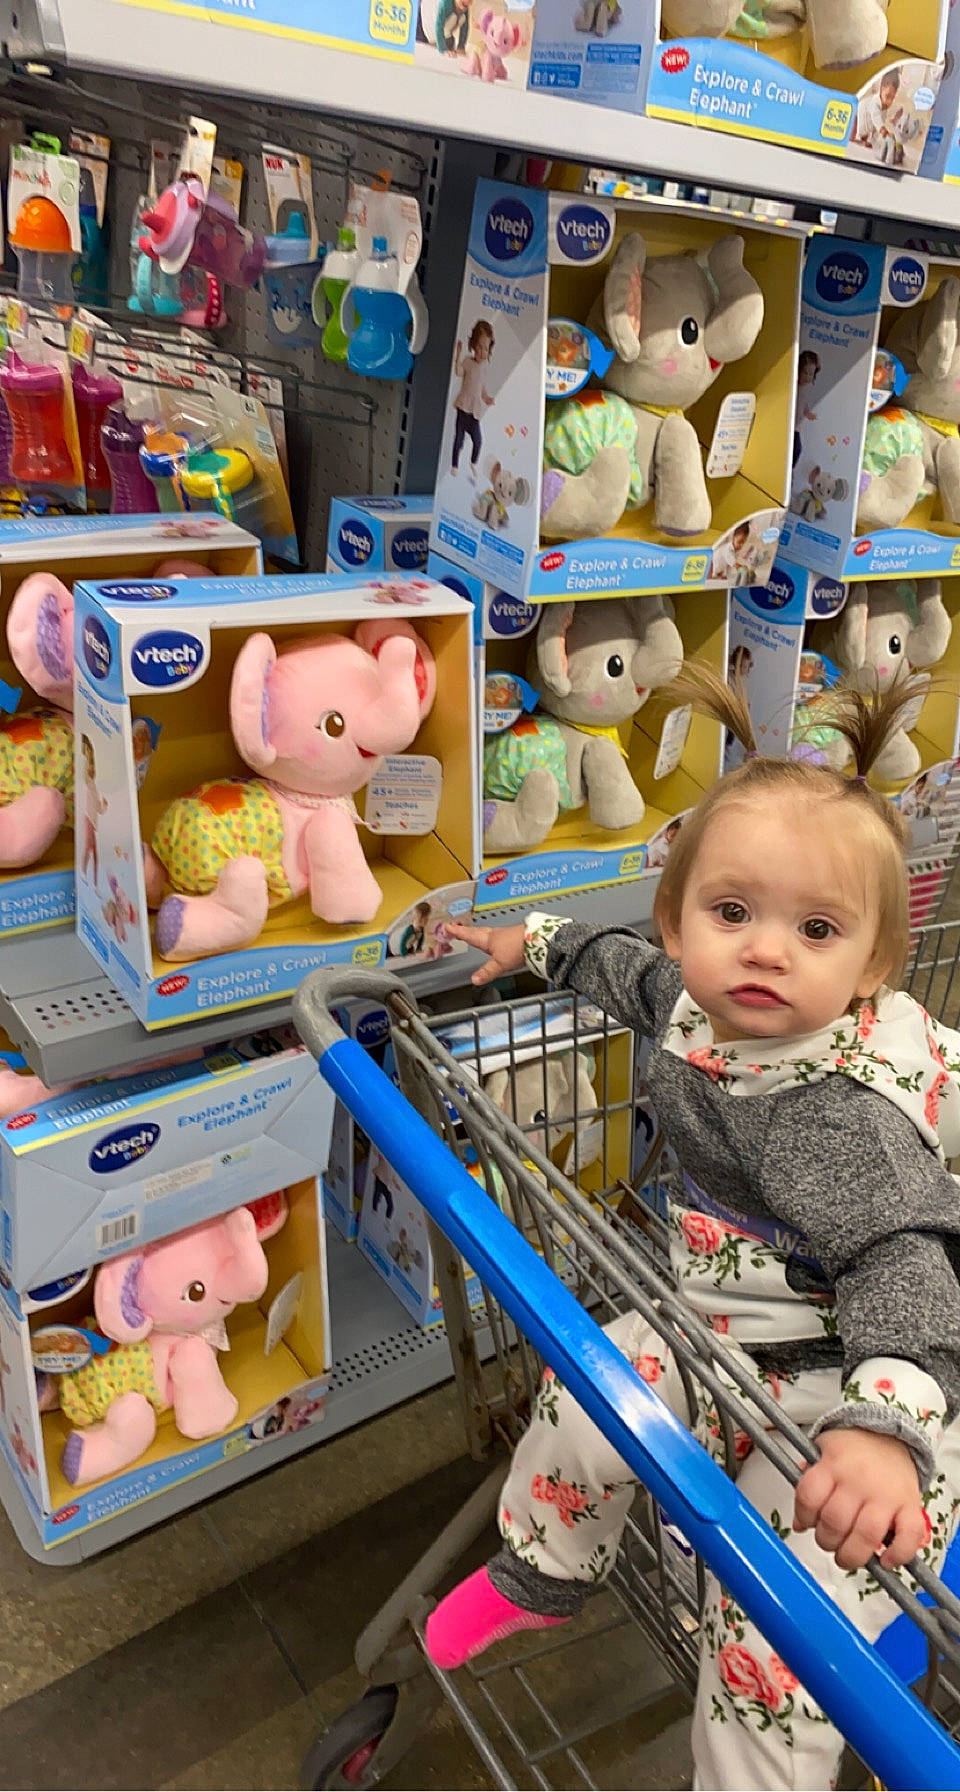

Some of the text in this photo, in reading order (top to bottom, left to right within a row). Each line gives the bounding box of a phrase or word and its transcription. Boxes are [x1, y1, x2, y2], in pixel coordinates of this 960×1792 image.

[374, 2, 407, 24] 6-36
[665, 53, 687, 67] NEW!
[693, 64, 806, 107] Explore & Crawl
[826, 108, 848, 125] 6-36
[490, 214, 529, 240] vtech
[560, 219, 605, 239] vtech
[823, 264, 864, 285] vtech
[891, 270, 922, 286] vtech
[340, 527, 372, 552] vtech
[873, 545, 907, 558] Explore
[917, 544, 941, 554] Crawl
[569, 556, 666, 574] Explore & Crawl
[870, 559, 909, 571] Elephant
[100, 585, 170, 596] vtech
[566, 574, 621, 590] Elephant
[813, 586, 843, 600] vtech
[492, 602, 533, 619] vtech
[136, 643, 198, 665] vtech
[166, 664, 195, 677] Baby
[372, 787, 393, 797] 45+
[512, 858, 605, 884] Explore & Crawl
[510, 878, 562, 897] Elephant
[1, 890, 66, 913] Explore
[1, 901, 76, 927] Elephant
[197, 952, 327, 992] Explore & Crawl
[160, 979, 186, 993] NEW!
[197, 979, 271, 1008] Elephant
[46, 1092, 113, 1119] Explore
[177, 1077, 293, 1128] Explore & Crawl
[53, 1099, 132, 1130] Elephant
[203, 1101, 268, 1132] Elephant
[94, 1130, 154, 1159] vtech
